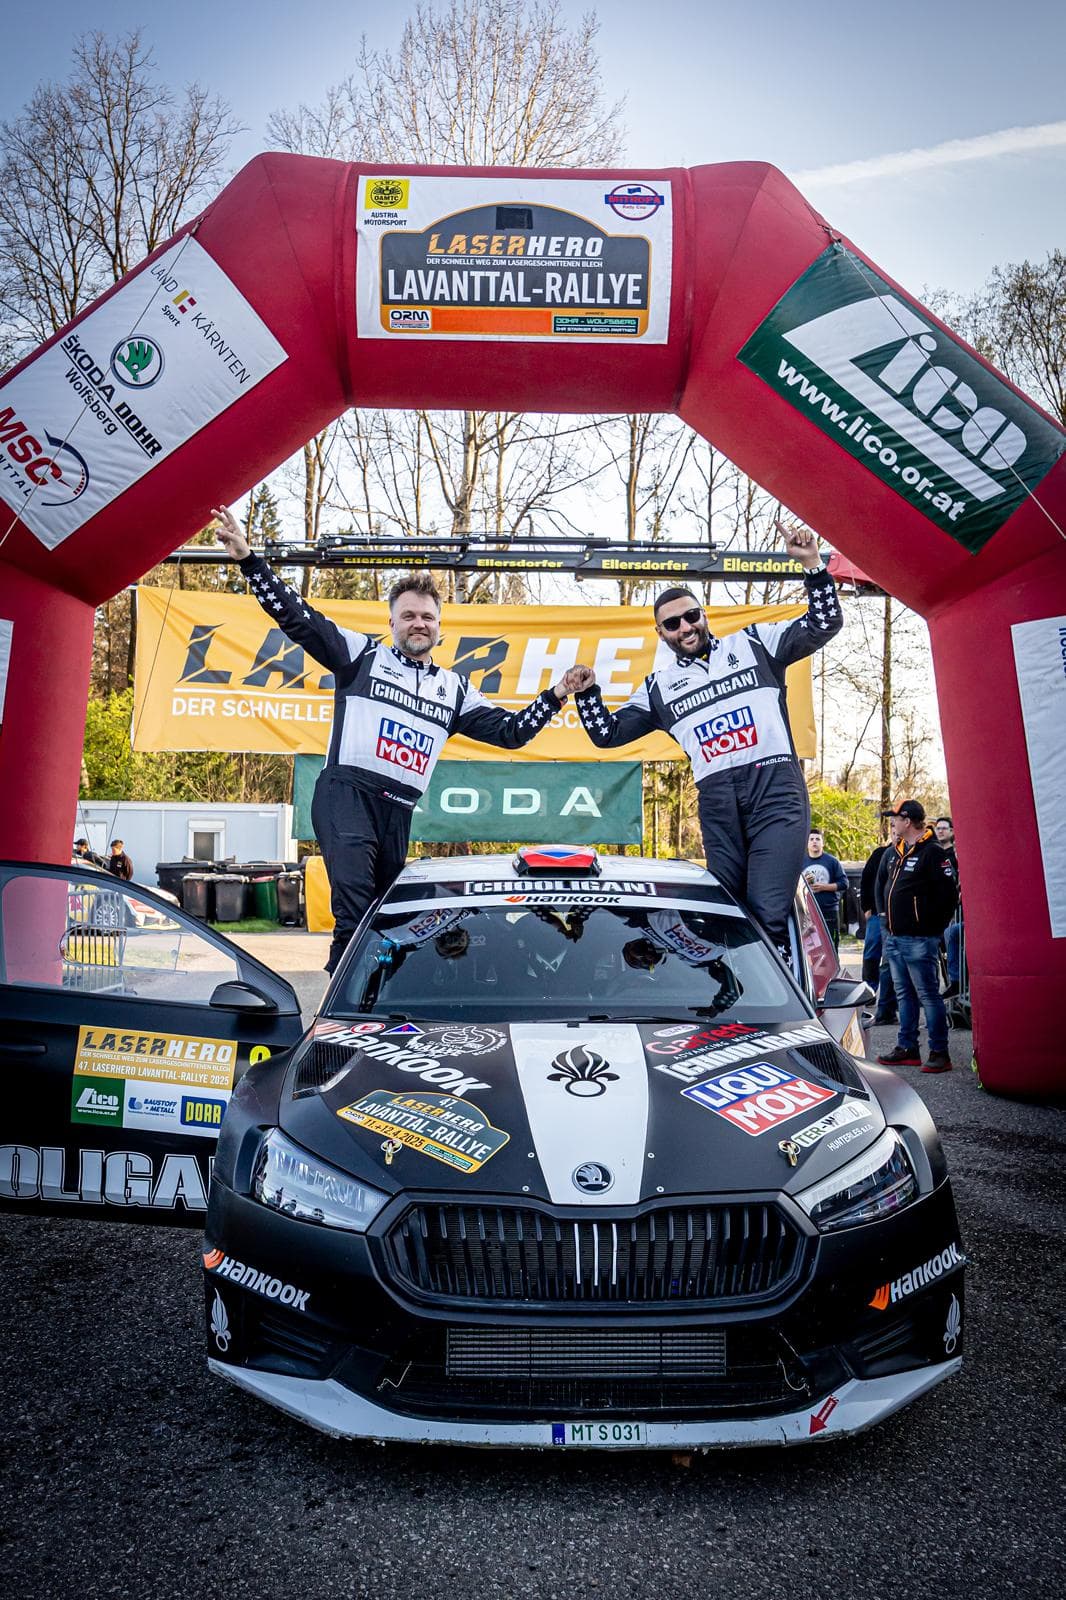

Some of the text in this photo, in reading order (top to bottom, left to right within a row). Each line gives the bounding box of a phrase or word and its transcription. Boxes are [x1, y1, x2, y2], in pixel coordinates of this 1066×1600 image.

[428, 233, 603, 257] LASERHERO
[427, 258, 441, 266] DER
[441, 258, 474, 266] SCHNELLE
[150, 264, 178, 293] LAND
[388, 269, 642, 305] LAVANTTAL-RALLYE
[161, 304, 181, 328] Sport
[391, 310, 429, 320] ORM
[191, 311, 251, 384] KÄRNTEN
[61, 334, 163, 458] ŠKODA DOHR
[65, 368, 119, 436] Wolfsberg
[0, 406, 63, 487] MSC
[777, 358, 967, 522] www.lico.or.at
[477, 558, 564, 569] Ellersdorfer
[601, 559, 689, 571] Ellersdorfer
[723, 558, 803, 573] Ellersdorfe
[171, 697, 333, 723] DER SCHNELLE
[696, 707, 755, 740] LIQUI
[381, 719, 433, 755] LIQUI
[702, 726, 756, 761] MOLY
[377, 738, 429, 774] MOLY
[82, 1031, 233, 1063] LASERHERO
[646, 1023, 759, 1054] Garrett
[673, 1030, 770, 1061] ADVANCING MOTION
[78, 1062, 230, 1085] 47. LASERHERO LAVANTTAL-RALLYE 2025
[691, 1063, 793, 1108] LIQUI
[144, 1098, 178, 1108] BAUSTOFF
[150, 1105, 175, 1115] METALL
[392, 1096, 486, 1132] LASERHERO
[726, 1080, 825, 1130] MOLY
[353, 1100, 492, 1161] LAVANTTAL-RALLYE
[571, 1424, 594, 1441] MT
